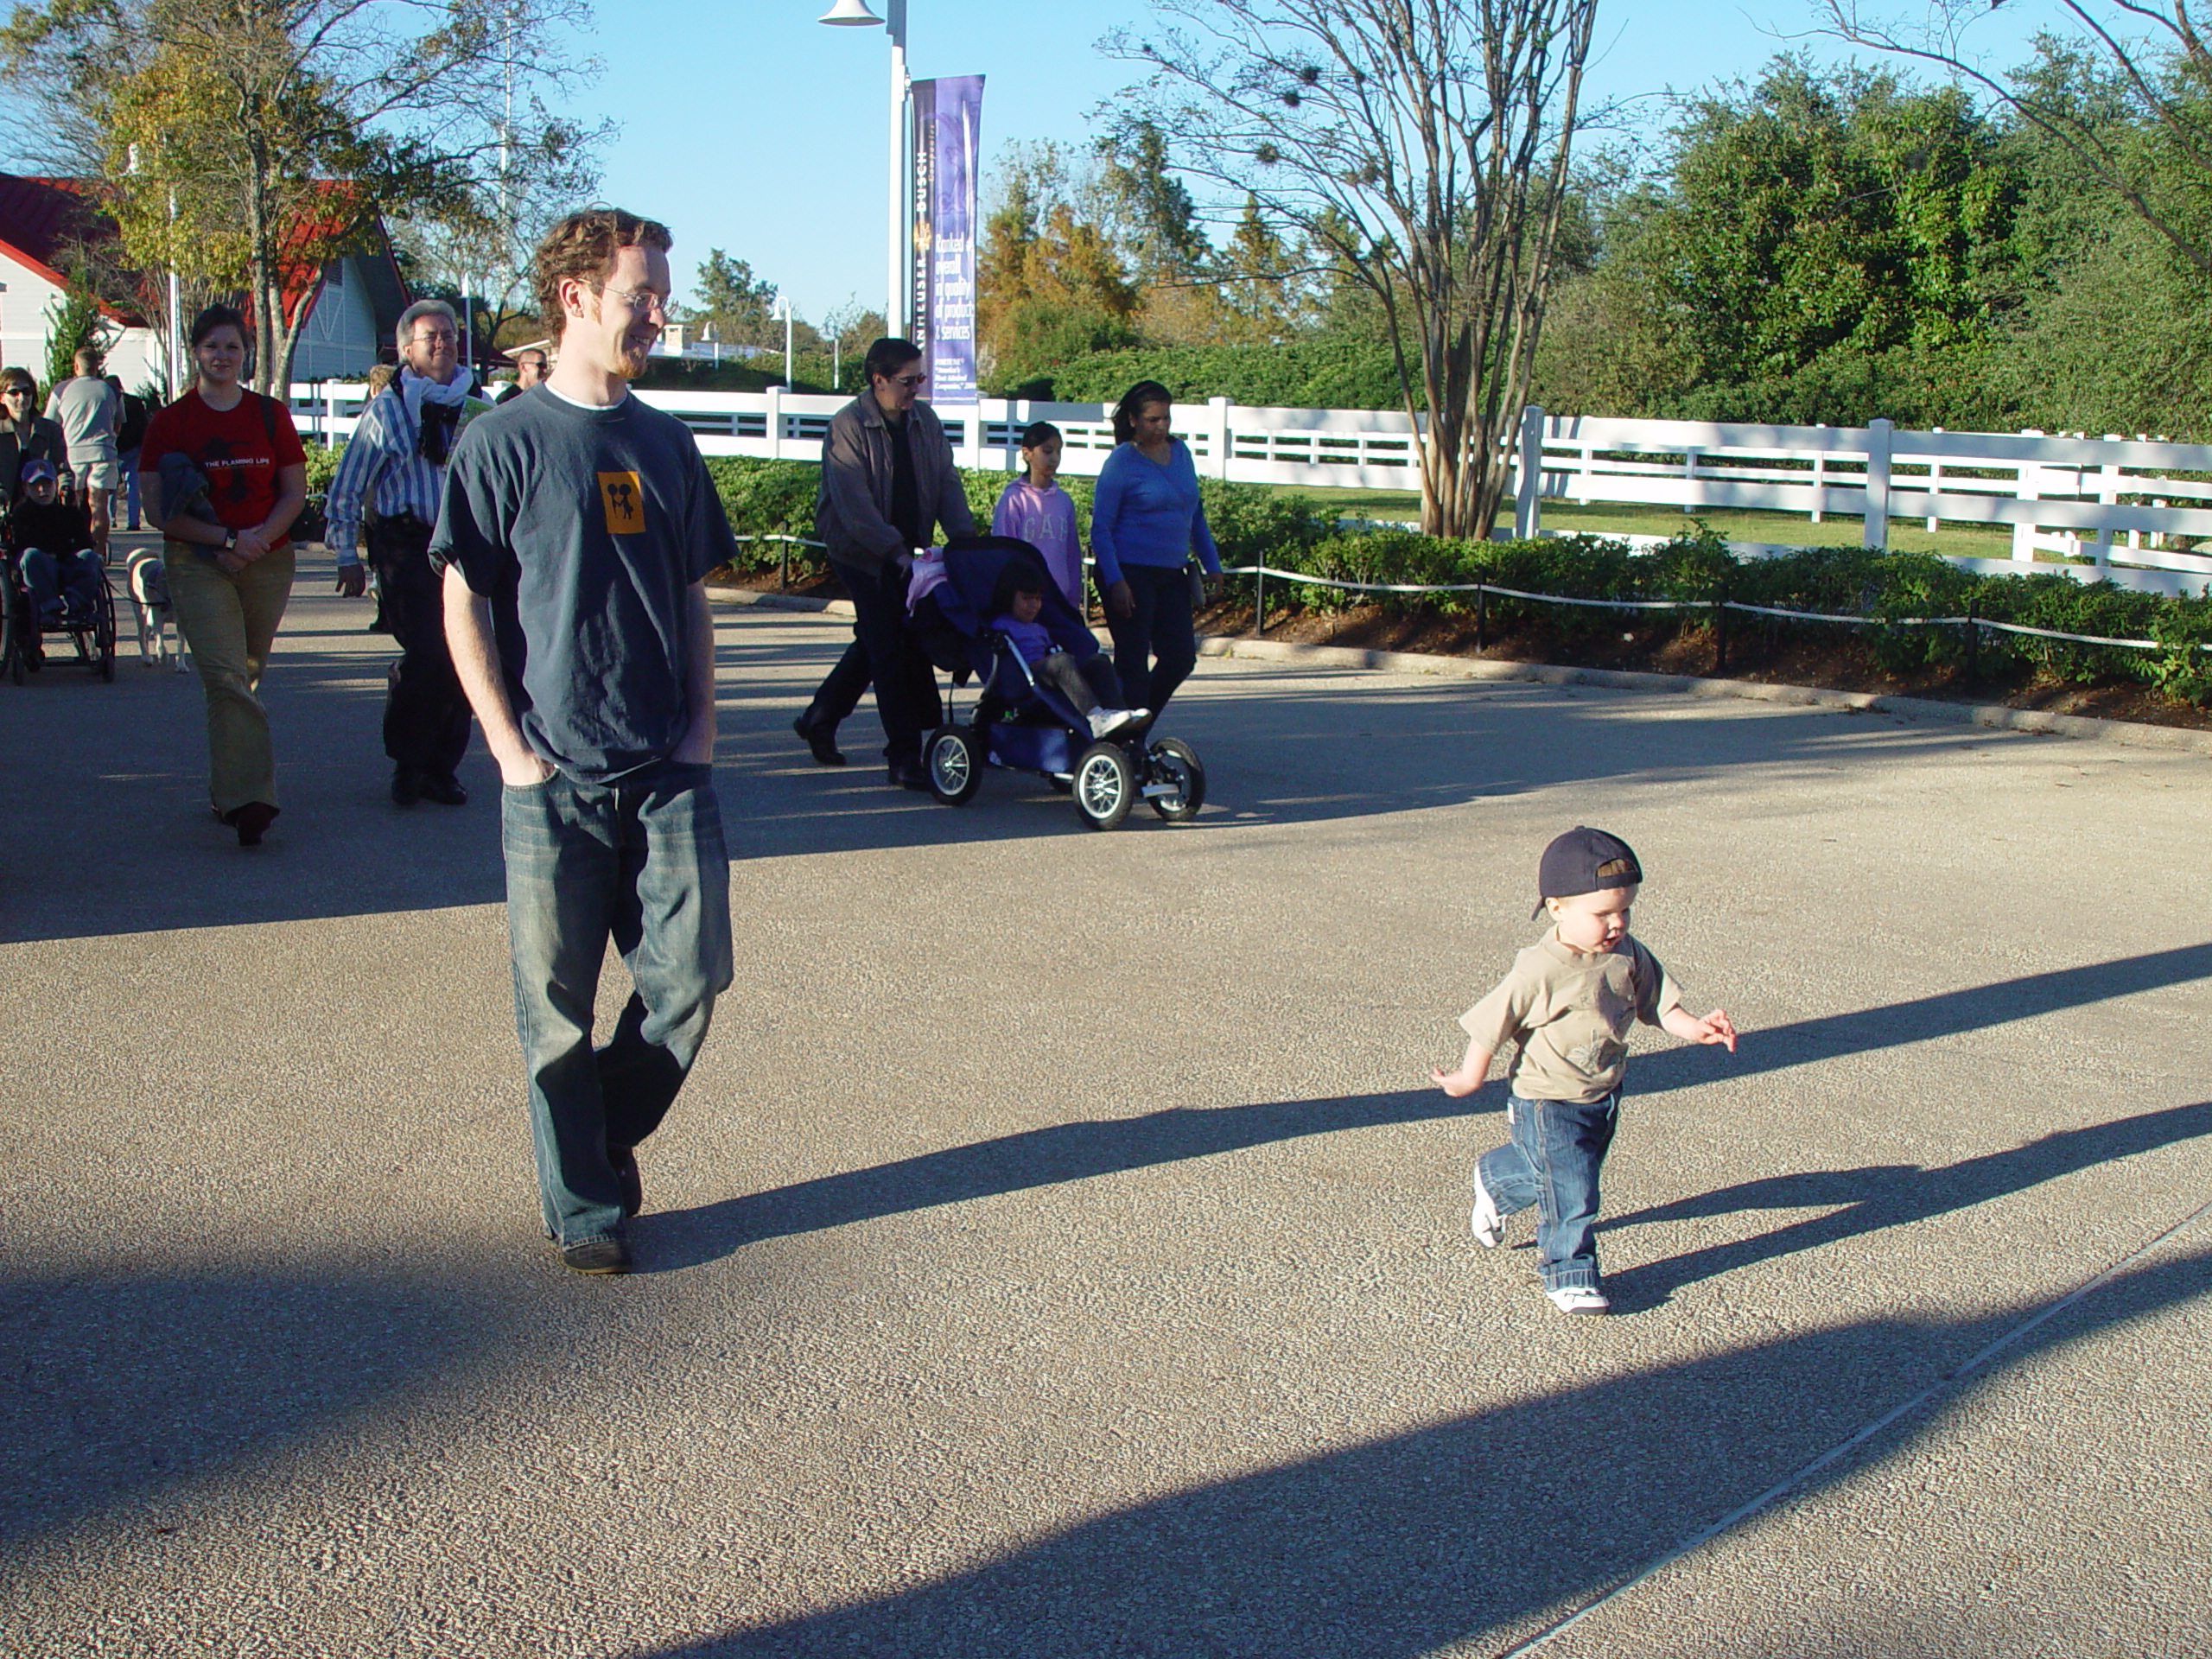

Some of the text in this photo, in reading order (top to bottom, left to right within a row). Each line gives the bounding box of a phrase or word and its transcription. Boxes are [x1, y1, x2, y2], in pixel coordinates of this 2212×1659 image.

[917, 152, 927, 212] BUSCH
[936, 232, 963, 253] Ranked
[935, 253, 961, 275] overall
[944, 276, 970, 301] quality
[917, 257, 926, 350] ANHEUSER
[935, 297, 944, 318] of
[941, 321, 970, 340] services
[222, 458, 254, 467] FLAMING
